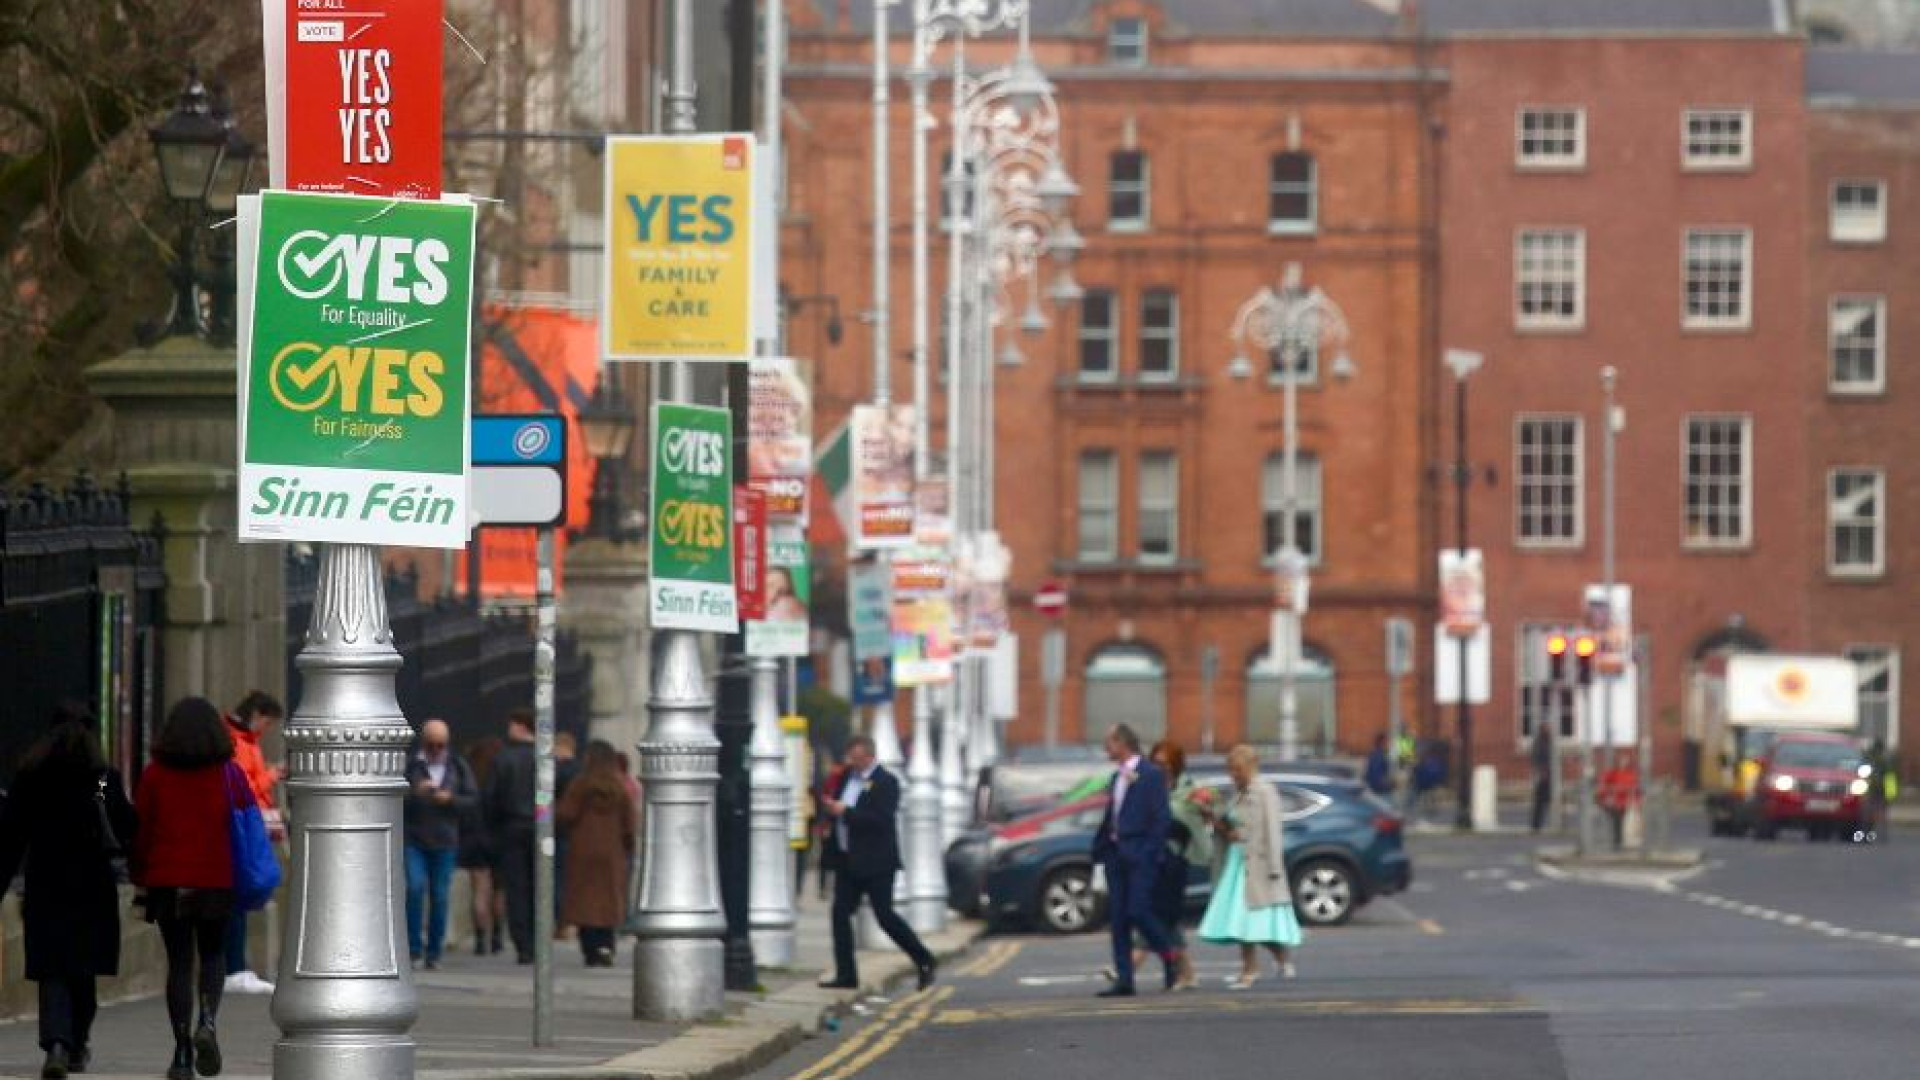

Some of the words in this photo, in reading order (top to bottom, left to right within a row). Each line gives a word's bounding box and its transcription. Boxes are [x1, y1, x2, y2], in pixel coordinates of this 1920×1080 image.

[303, 26, 337, 36] VOTE
[338, 49, 390, 104] YES
[338, 108, 390, 163] YES
[624, 194, 735, 244] YES
[338, 234, 450, 305] YES
[638, 267, 720, 283] FAMILY
[321, 304, 343, 323] For
[349, 305, 406, 329] Equality
[648, 299, 708, 317] CARE
[331, 346, 445, 417] YES
[314, 416, 334, 435] For
[341, 418, 402, 439] Fairness
[683, 430, 724, 476] YES
[251, 477, 349, 519] Sinn
[360, 482, 455, 526] Féin
[682, 502, 725, 548] YES
[656, 586, 694, 615] Sinn
[698, 589, 733, 617] Féin
